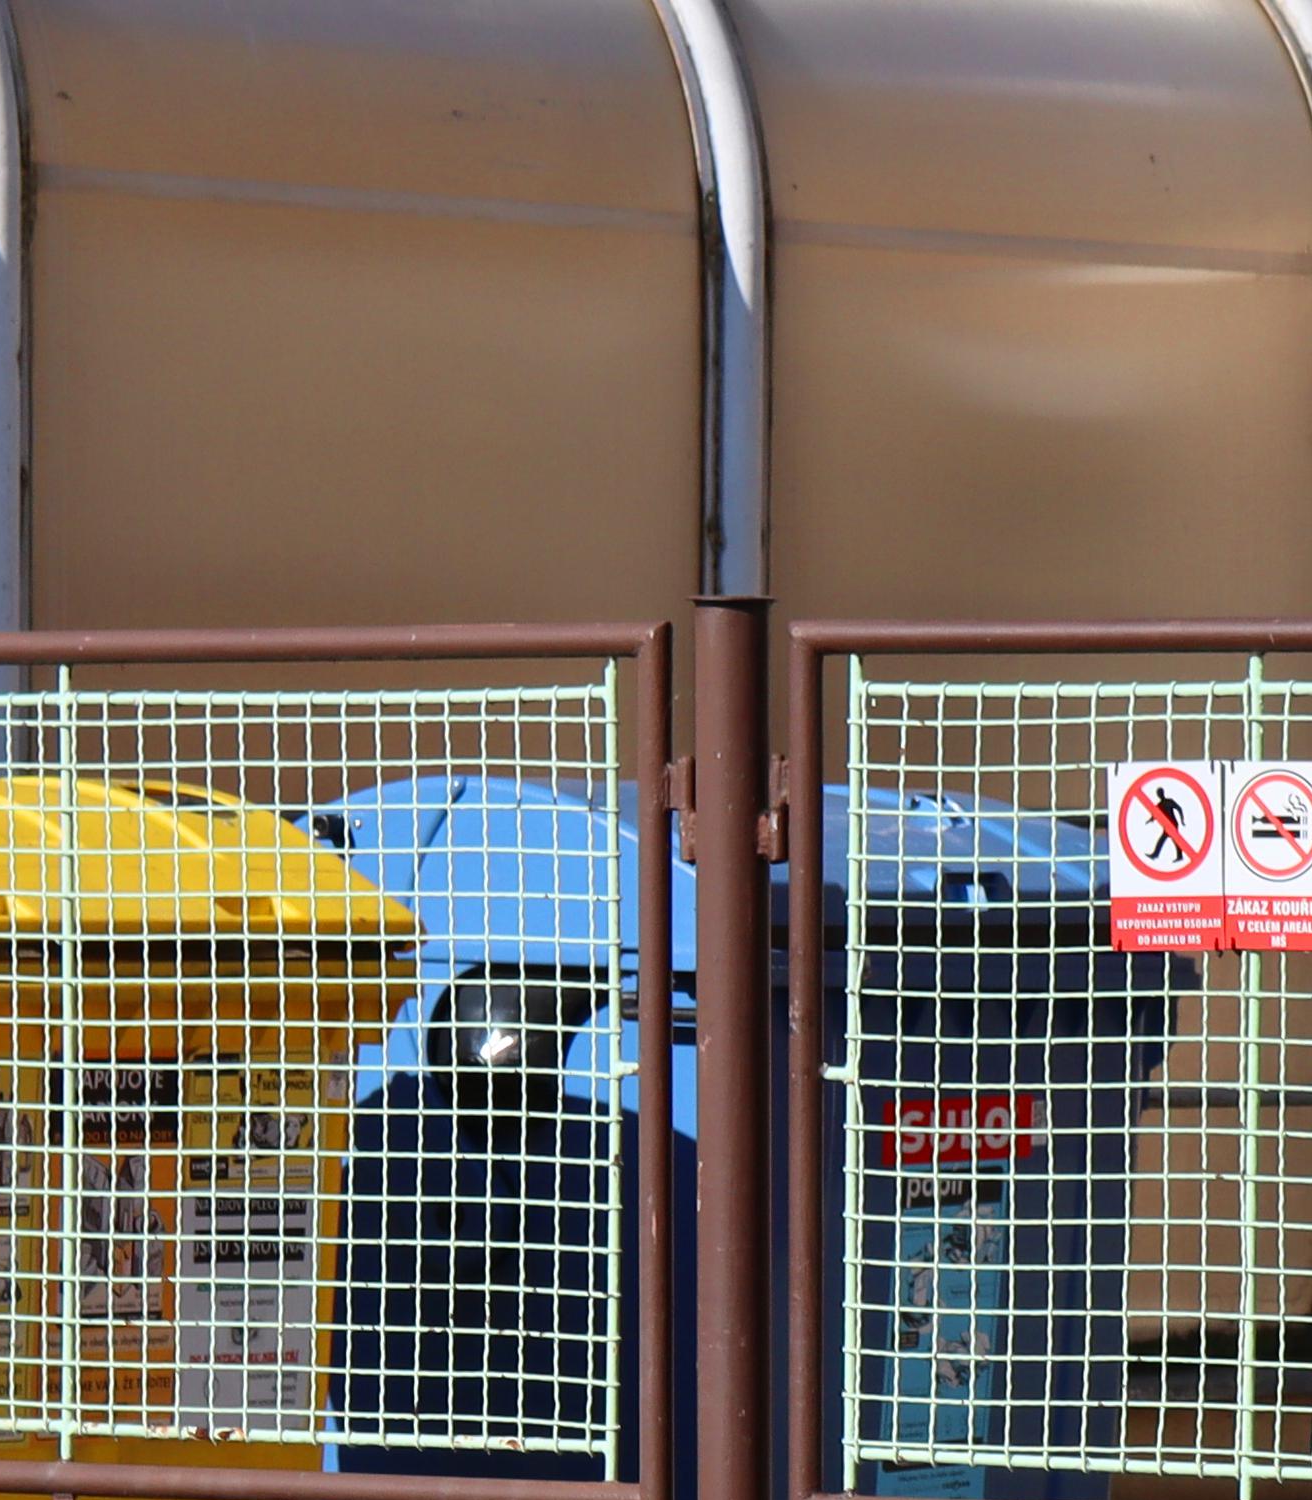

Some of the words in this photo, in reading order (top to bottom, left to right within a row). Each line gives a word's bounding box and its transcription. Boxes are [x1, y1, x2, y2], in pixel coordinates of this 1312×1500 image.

[1165, 903, 1201, 913] VSTUPU
[1227, 897, 1269, 916] ZÁKAZ
[1237, 920, 1246, 933] V
[1247, 919, 1281, 933] CELÉM
[1137, 934, 1151, 946] DO
[1271, 933, 1287, 948] MŠ
[900, 1105, 1010, 1155] SULO
